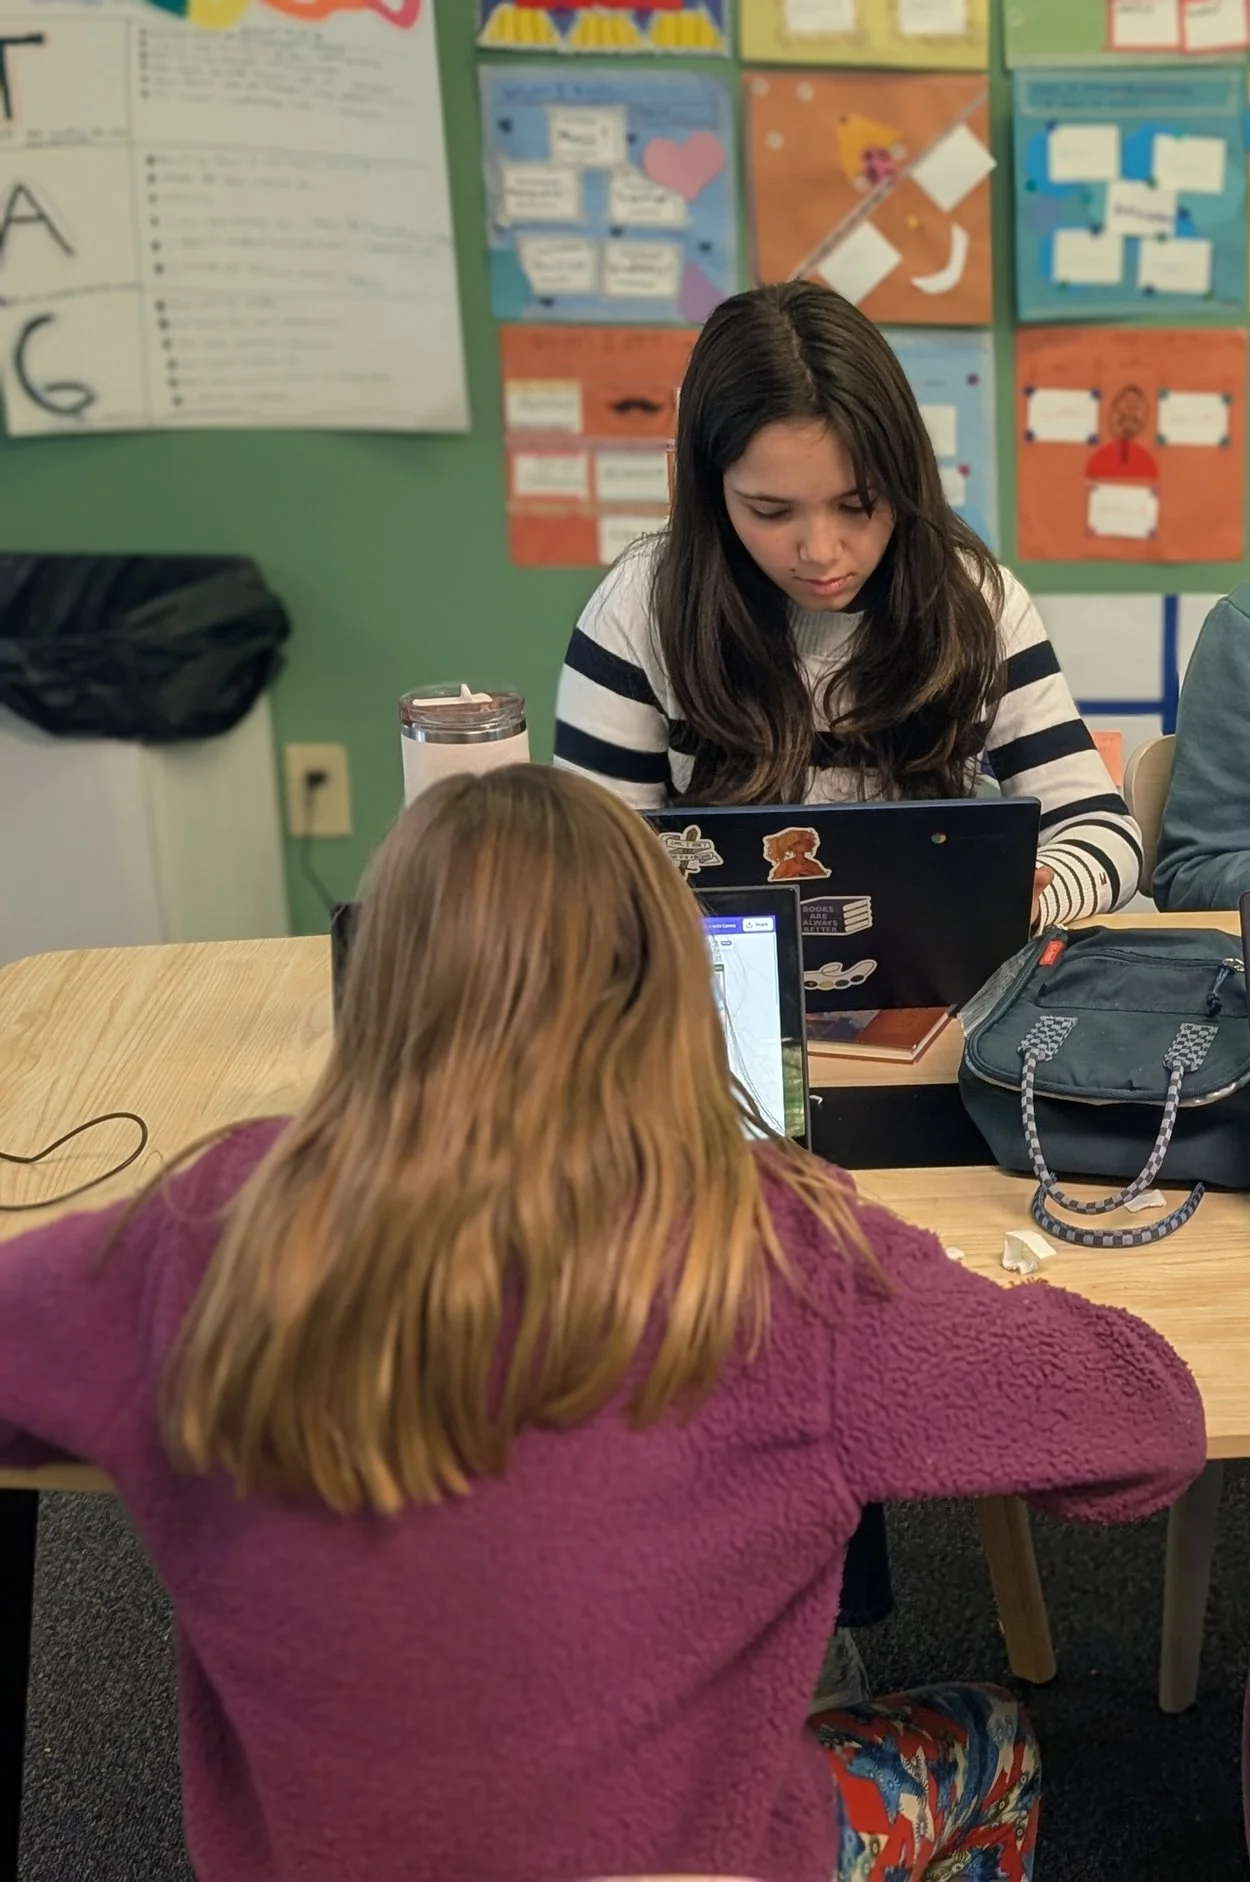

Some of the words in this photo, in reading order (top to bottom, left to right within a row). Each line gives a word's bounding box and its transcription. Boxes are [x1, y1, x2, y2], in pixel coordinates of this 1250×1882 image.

[0, 183, 75, 258] A
[13, 312, 99, 416] G
[802, 905, 834, 913] BOOKS
